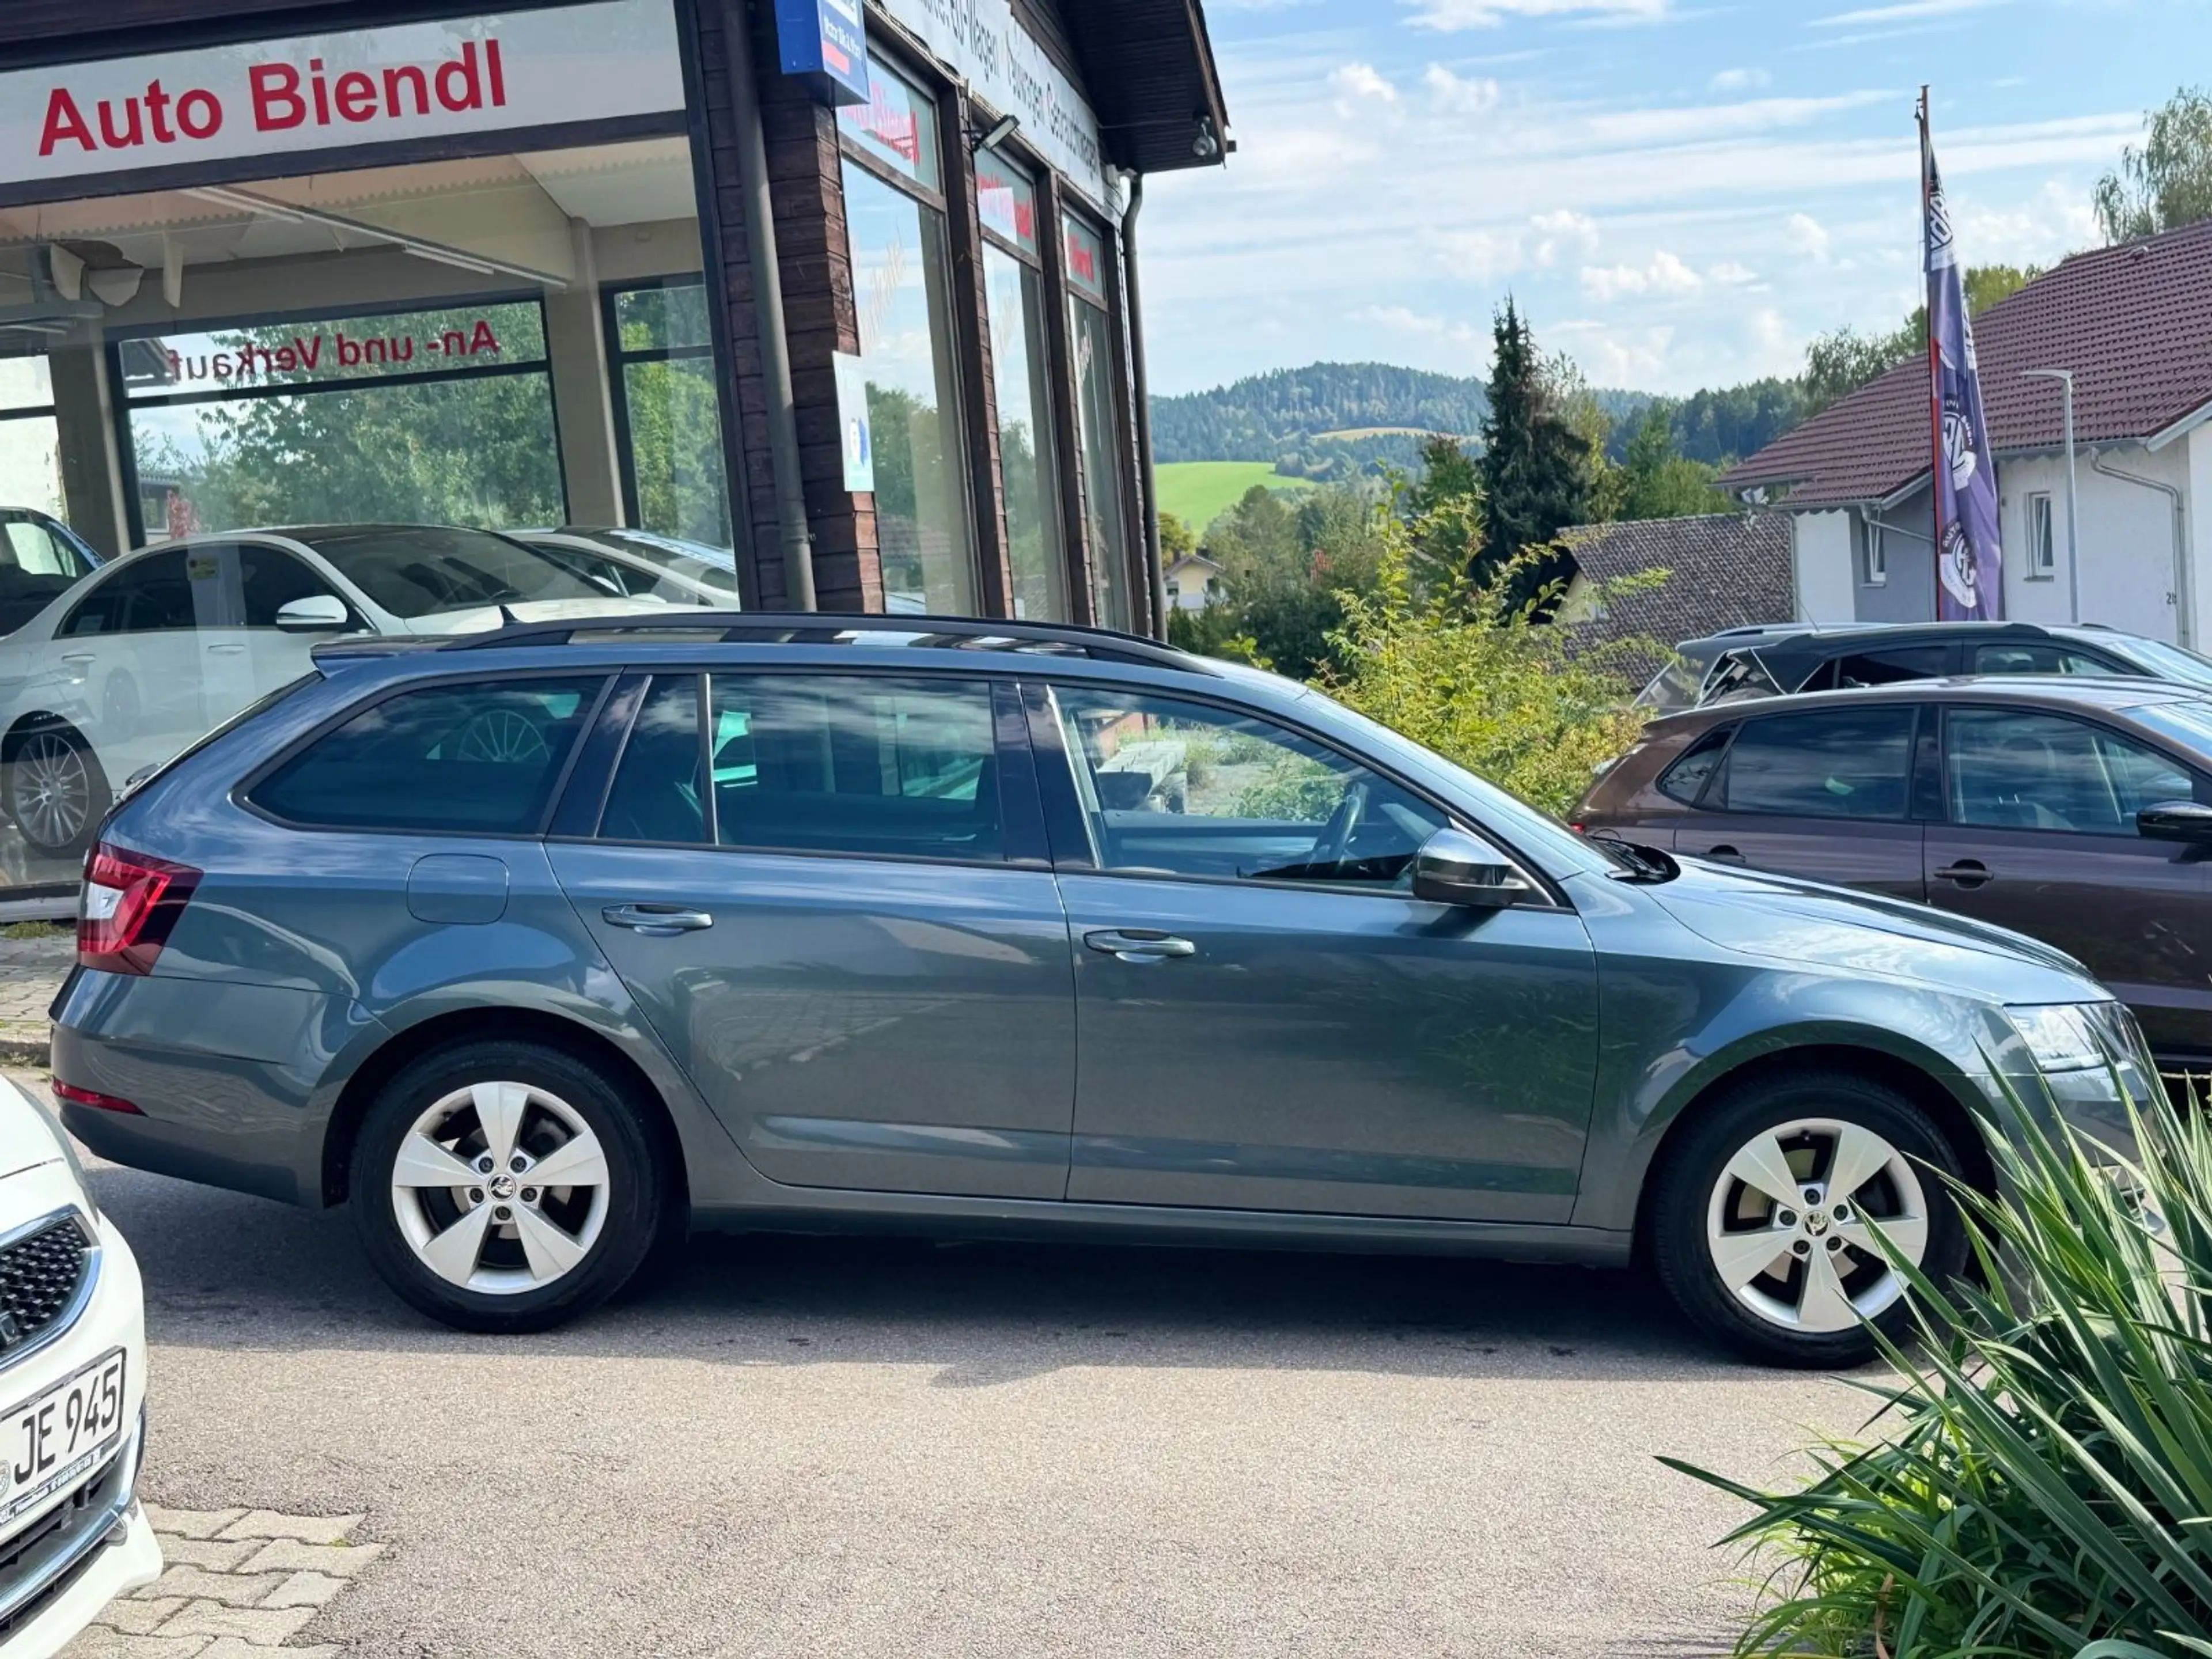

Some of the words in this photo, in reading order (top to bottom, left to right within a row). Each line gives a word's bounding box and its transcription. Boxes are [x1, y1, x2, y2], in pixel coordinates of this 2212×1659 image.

[39, 78, 224, 157] Auto
[248, 39, 506, 132] Biendl
[14, 1402, 56, 1485] JE
[66, 1363, 119, 1454] 945
